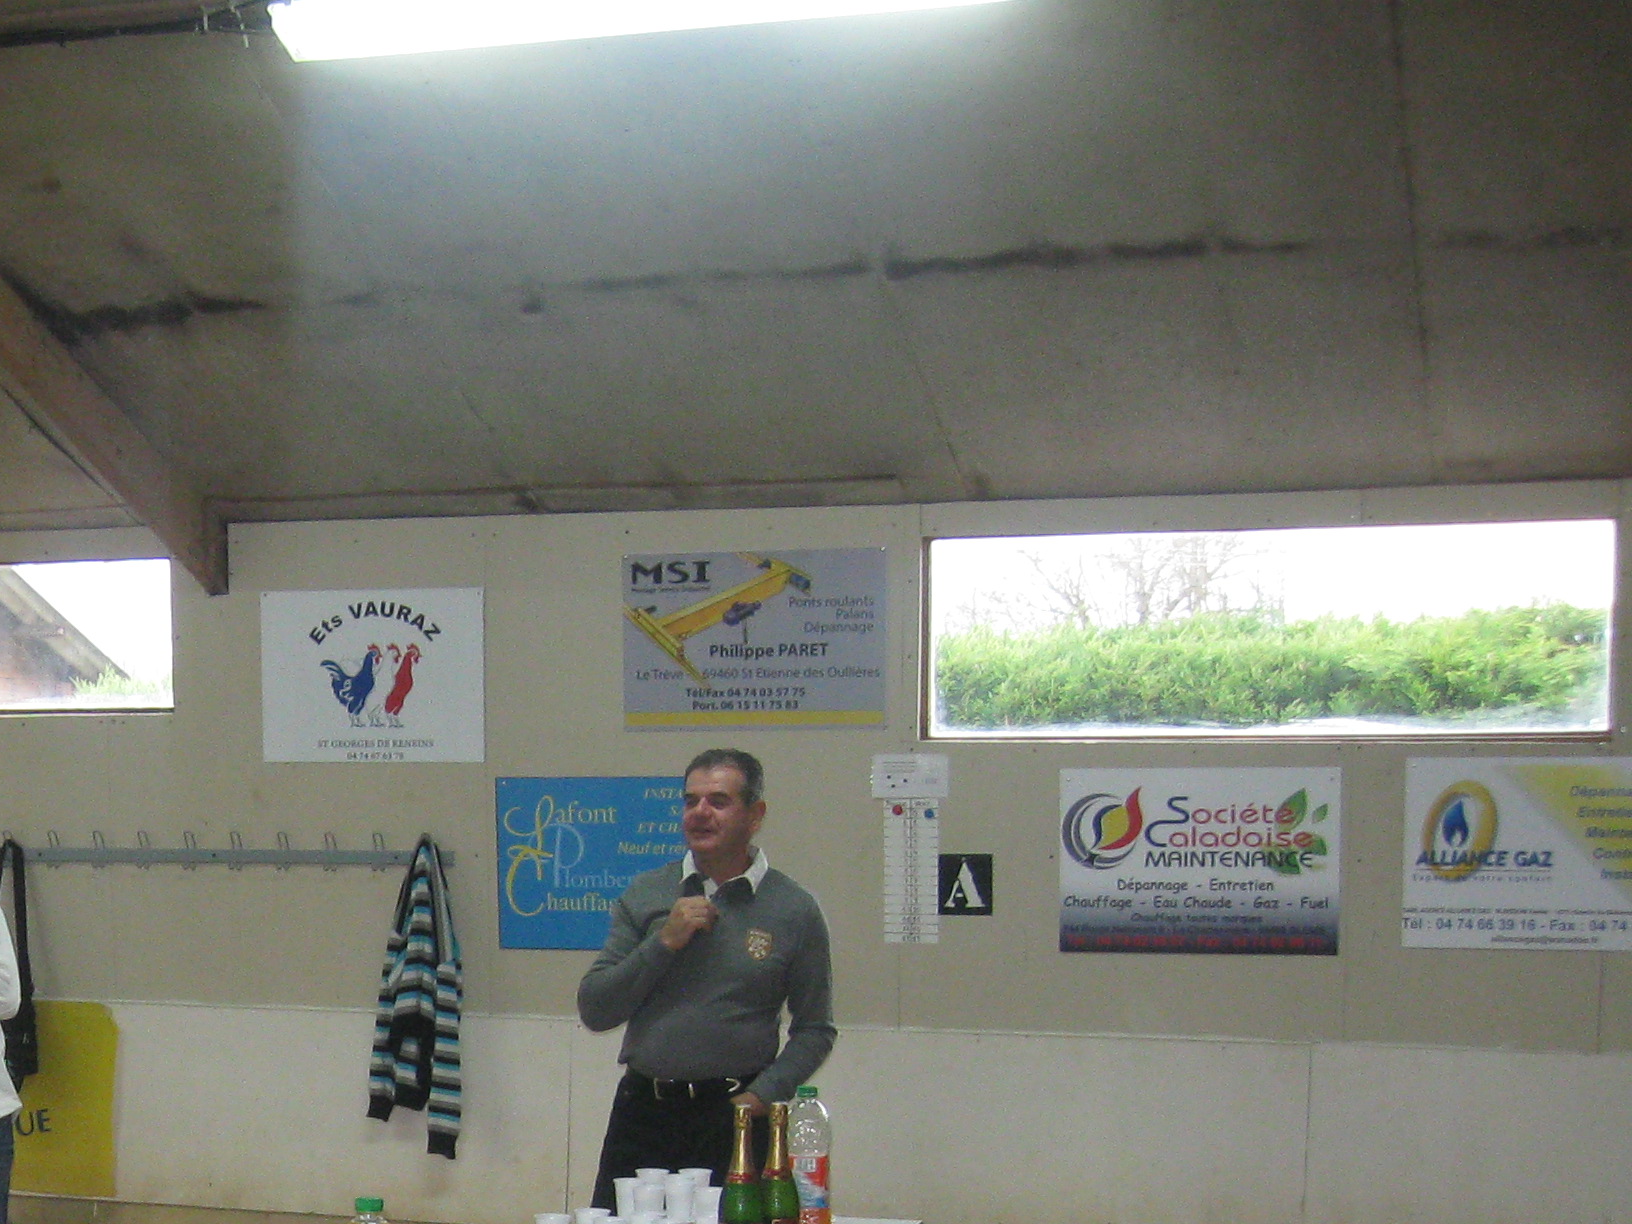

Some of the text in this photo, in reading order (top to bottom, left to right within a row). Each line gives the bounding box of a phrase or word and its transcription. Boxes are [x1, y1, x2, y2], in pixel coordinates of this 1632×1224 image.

[631, 561, 711, 585] MSI
[308, 600, 442, 646] Ets VAURAZ
[836, 609, 874, 620] Palans
[804, 620, 874, 635] Dépannage
[709, 643, 829, 660] Philippe PARET
[1167, 796, 1296, 824] Société
[1145, 820, 1315, 848] Caladoise
[1144, 851, 1315, 868] MAINTENANCE
[1416, 851, 1553, 867] ALLIANCE GAZ
[944, 856, 986, 908] A
[1118, 878, 1188, 894] Dépannage
[1209, 878, 1274, 891] Entretien
[1064, 896, 1132, 911] Chauffage
[1153, 896, 1178, 908] Eau
[1183, 896, 1232, 909] Chaude
[1253, 897, 1279, 909] Gaz
[1300, 896, 1329, 909] Fuel
[1456, 918, 1473, 930] 74
